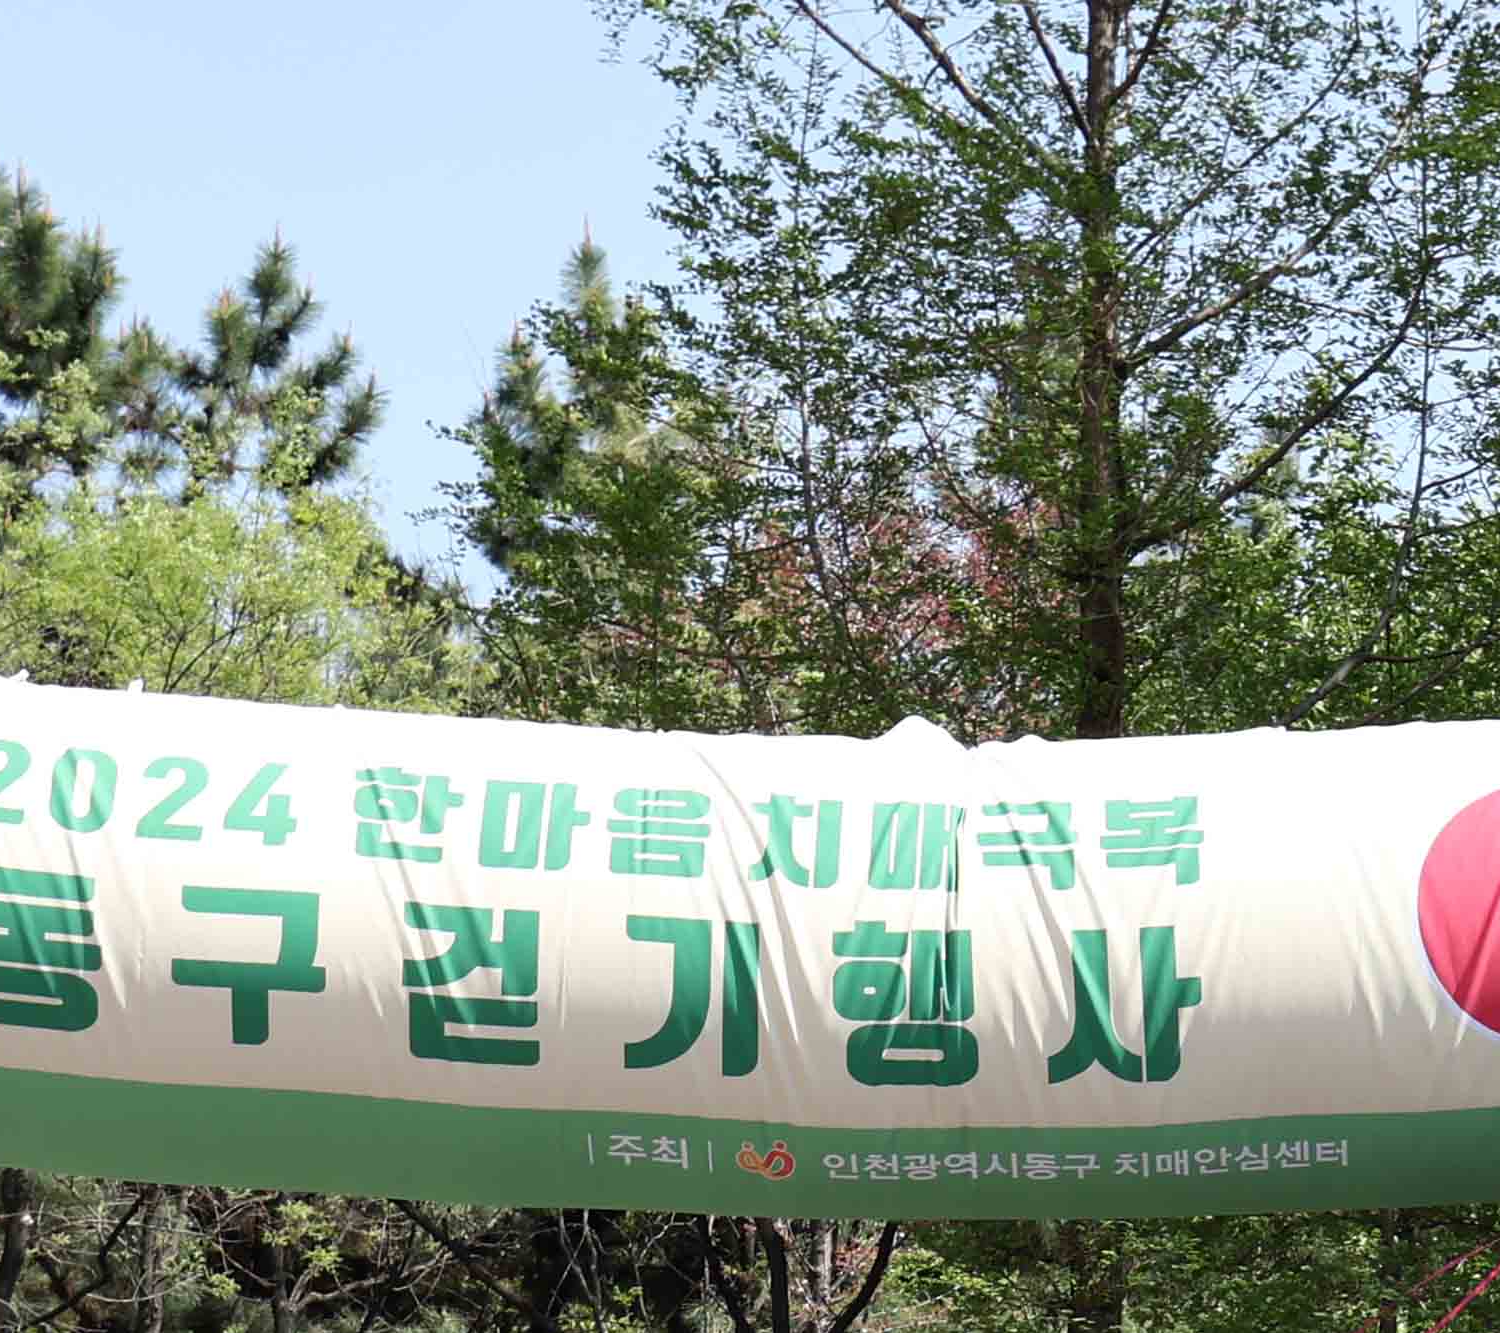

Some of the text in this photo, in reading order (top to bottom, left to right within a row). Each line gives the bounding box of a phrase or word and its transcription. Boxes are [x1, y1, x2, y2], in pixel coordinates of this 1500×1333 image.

[353, 765, 711, 878] 한마음
[748, 793, 1204, 892] 치매극복
[607, 1134, 1349, 1180] 주최 인천광역시동구 치매안심센터
